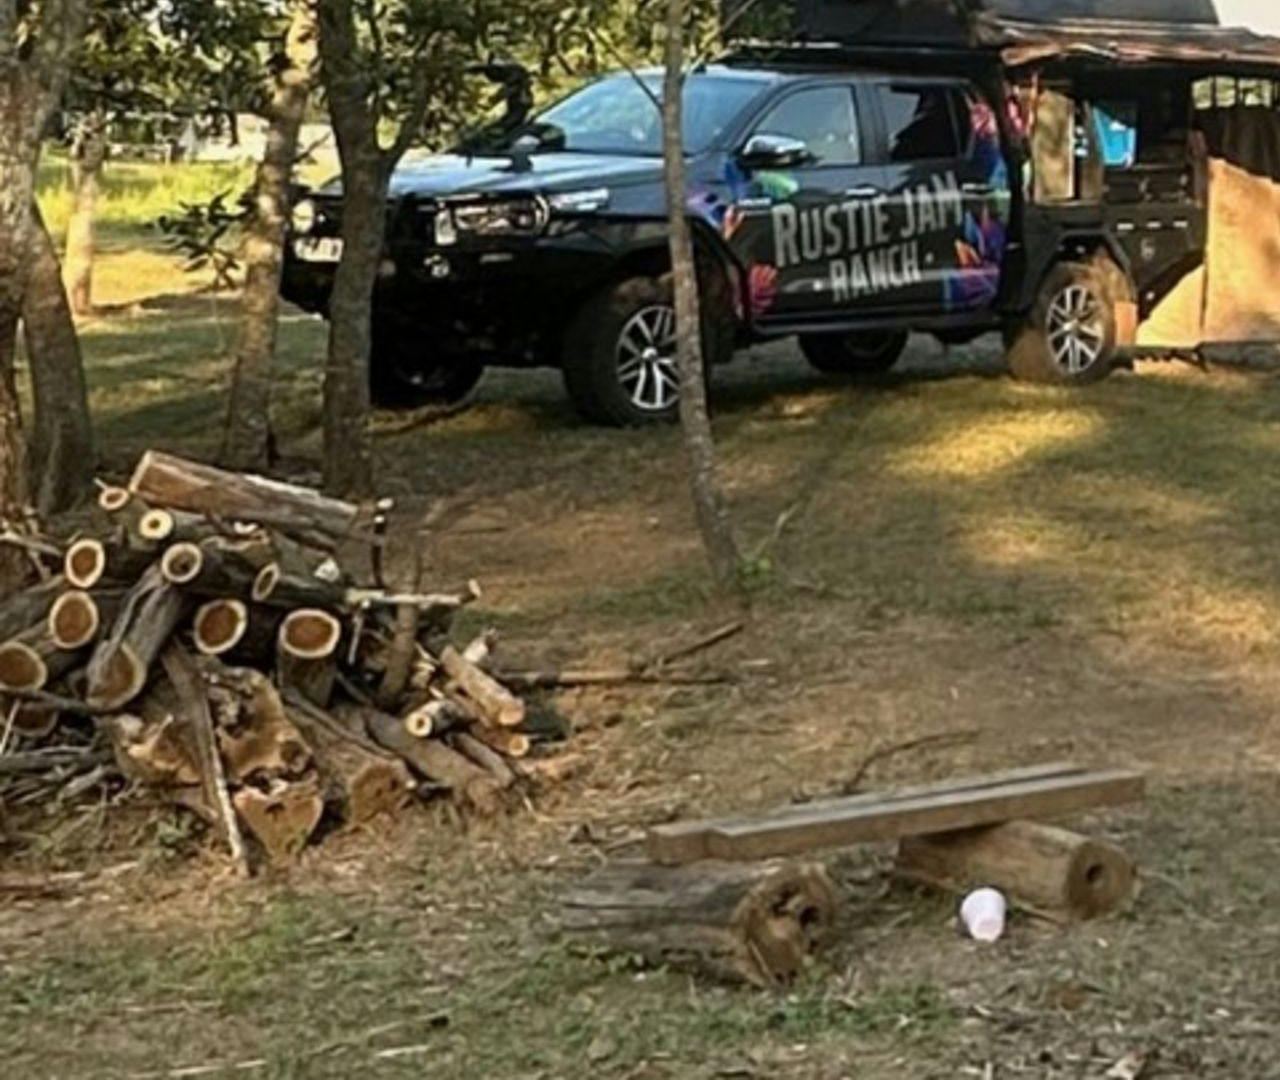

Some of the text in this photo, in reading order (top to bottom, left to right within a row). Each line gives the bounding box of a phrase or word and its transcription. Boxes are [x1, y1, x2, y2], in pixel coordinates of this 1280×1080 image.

[771, 171, 962, 268] RUSTIE JAM
[830, 241, 922, 302] RANCH
